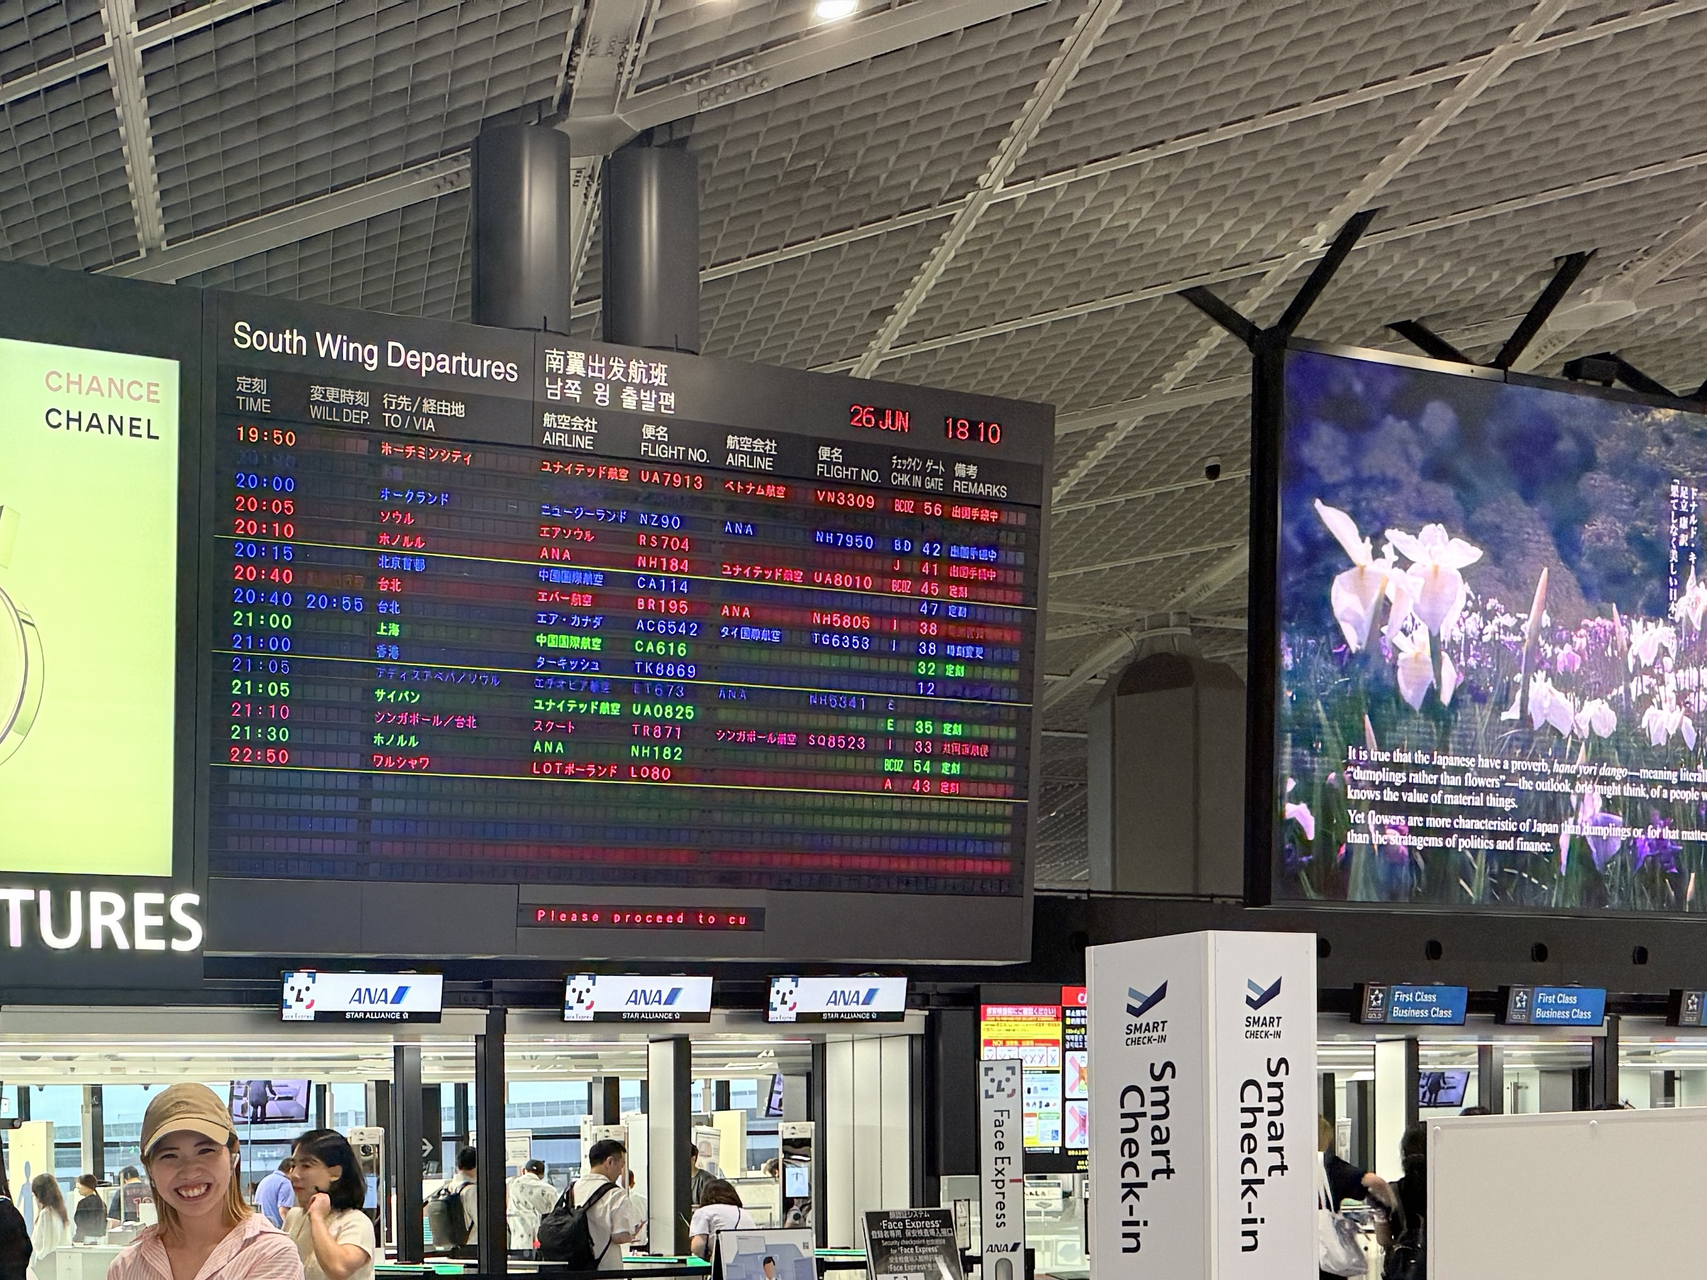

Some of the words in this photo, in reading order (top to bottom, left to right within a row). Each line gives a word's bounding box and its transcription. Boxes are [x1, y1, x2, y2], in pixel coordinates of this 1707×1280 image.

[234, 321, 307, 356] South
[316, 332, 378, 371] Wing
[387, 340, 519, 383] Departures
[544, 348, 669, 388] 南翼出发航班
[45, 370, 160, 404] CHANCE
[236, 376, 268, 395] 定刻
[310, 385, 370, 408] 変更時刻
[545, 376, 582, 402] 남쪽
[592, 382, 611, 407] 윙
[620, 386, 675, 415] 출발편
[236, 396, 271, 415] TIME
[45, 407, 160, 440] CHANEL
[849, 404, 875, 429] 26
[879, 408, 909, 433] JUN
[945, 417, 969, 440] 18
[977, 421, 1002, 444] 10
[237, 426, 296, 447] 19:50
[381, 442, 472, 466] ホーチミンシティ
[541, 461, 629, 482] ユナイテッド航空
[640, 470, 703, 490] UA7913
[817, 490, 875, 509] VN3309
[232, 680, 290, 697] 21:05
[534, 699, 621, 716] ユナイテッド航空
[632, 703, 694, 720] UA0825
[1348, 746, 1357, 760] It
[1359, 748, 1367, 760] is
[1370, 749, 1390, 763] true
[1393, 750, 1412, 764] that
[1414, 751, 1429, 765] the
[1432, 752, 1475, 769] Japanese
[1478, 755, 1501, 770] have
[1347, 786, 1380, 801] knows
[1383, 788, 1399, 802] the
[1402, 789, 1428, 803] value
[1430, 790, 1442, 804] of
[1444, 791, 1483, 806] material
[1485, 794, 1518, 810] things.
[537, 909, 599, 923] Please
[613, 912, 684, 924] proceed
[698, 912, 715, 924] to
[728, 915, 746, 925] cu
[349, 988, 389, 1004] ANA
[625, 988, 662, 1006] ANA
[1395, 990, 1413, 1002] First
[1416, 991, 1437, 1003] Class
[345, 1011, 364, 1020] STAR
[365, 1011, 400, 1020] ALLIANCE
[1245, 1016, 1282, 1028] SMART
[1393, 1005, 1428, 1018] Business
[1430, 1007, 1452, 1018] Class
[1125, 1020, 1168, 1035] SMART
[1245, 1029, 1282, 1039] CHECK-IN
[1125, 1034, 1167, 1047] CHECK-IN
[1150, 1060, 1176, 1181] Smart
[1266, 1056, 1290, 1177] Smart
[993, 1109, 1011, 1151] Face
[1119, 1084, 1148, 1254] Check-in
[1239, 1078, 1265, 1253] Check-in
[993, 1156, 1012, 1229] Express
